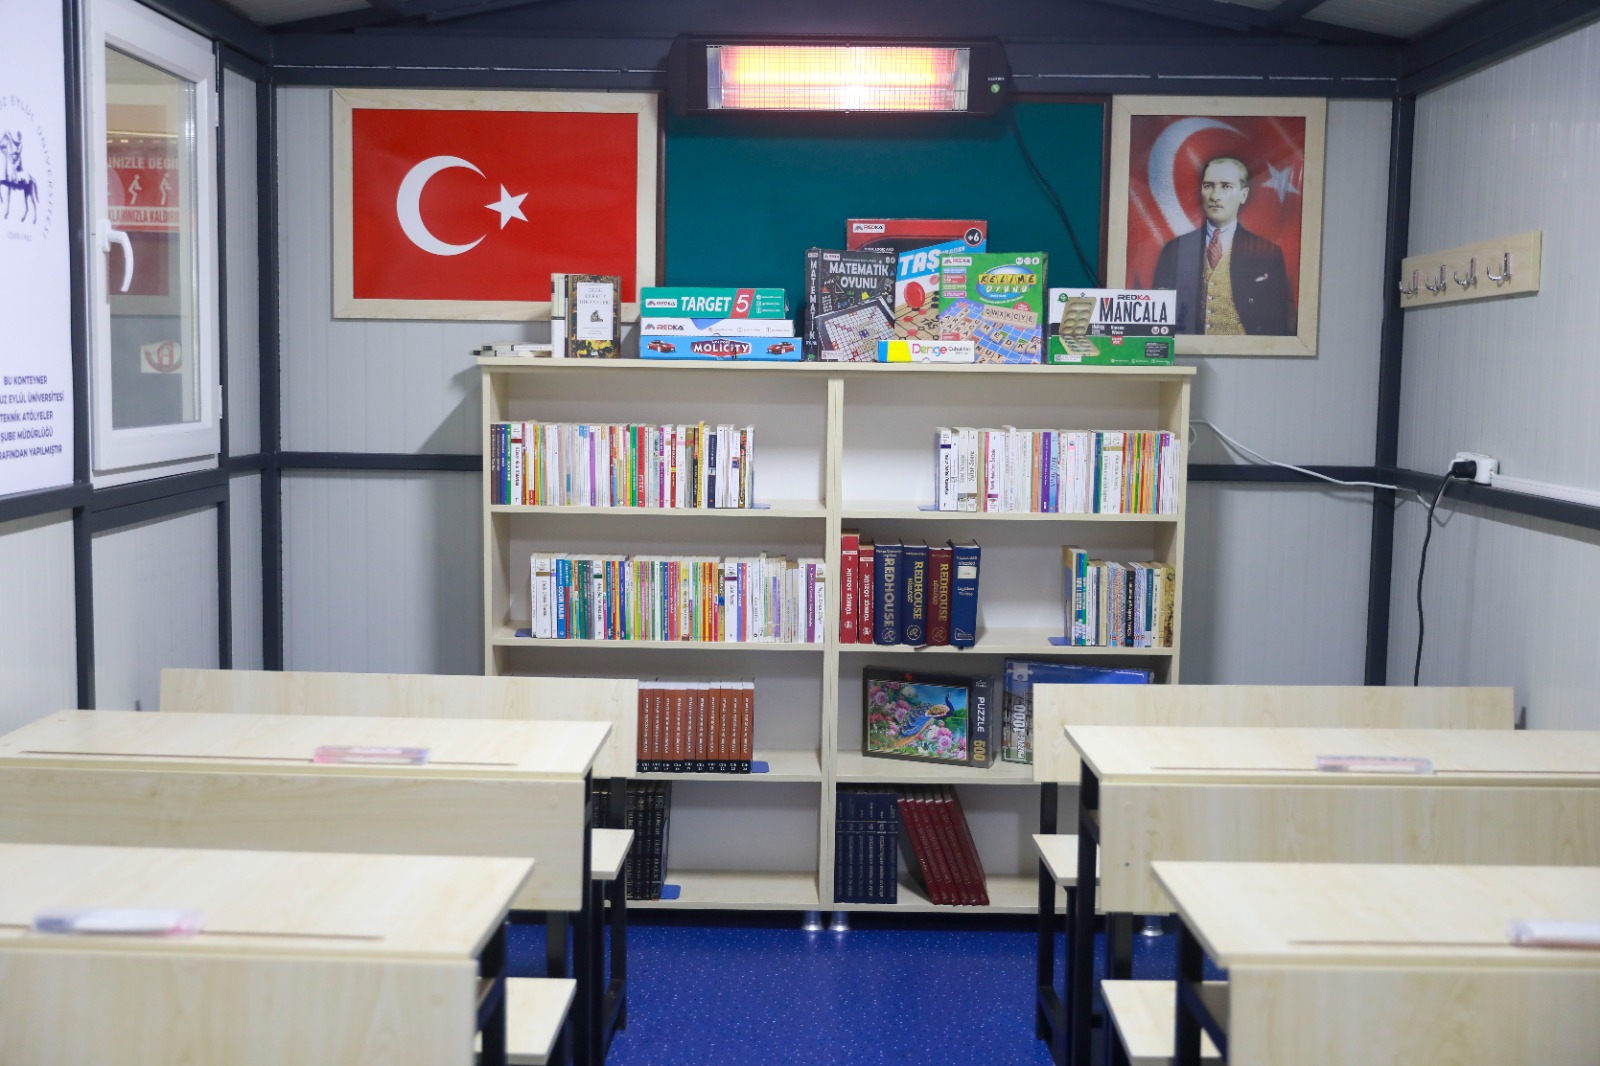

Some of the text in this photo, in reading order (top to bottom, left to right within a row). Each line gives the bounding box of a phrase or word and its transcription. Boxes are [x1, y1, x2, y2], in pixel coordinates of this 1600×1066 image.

[967, 232, 980, 243] +6
[829, 260, 889, 276] MATEMATİK
[900, 249, 941, 276] TAŞ
[840, 277, 877, 289] OYUNU
[985, 285, 1030, 293] OYUNU
[681, 296, 732, 312] TARGET
[735, 294, 750, 313] 5
[1100, 297, 1168, 323] MANCALA
[911, 343, 948, 357] Denge
[3, 375, 48, 386] BU KONTEYNER
[8, 391, 27, 404] EYLÜL
[22, 409, 54, 421] ATÖLYELER
[0, 432, 16, 444] ŞUBE
[863, 574, 871, 596] SÖZLÜK
[883, 557, 896, 627] REDHOUSE
[913, 560, 924, 620] REDHOUSE
[938, 563, 949, 622] REDHOUSE
[977, 696, 986, 733] PUZZLE
[1012, 704, 1026, 735] 1000
[973, 739, 986, 762] 500
